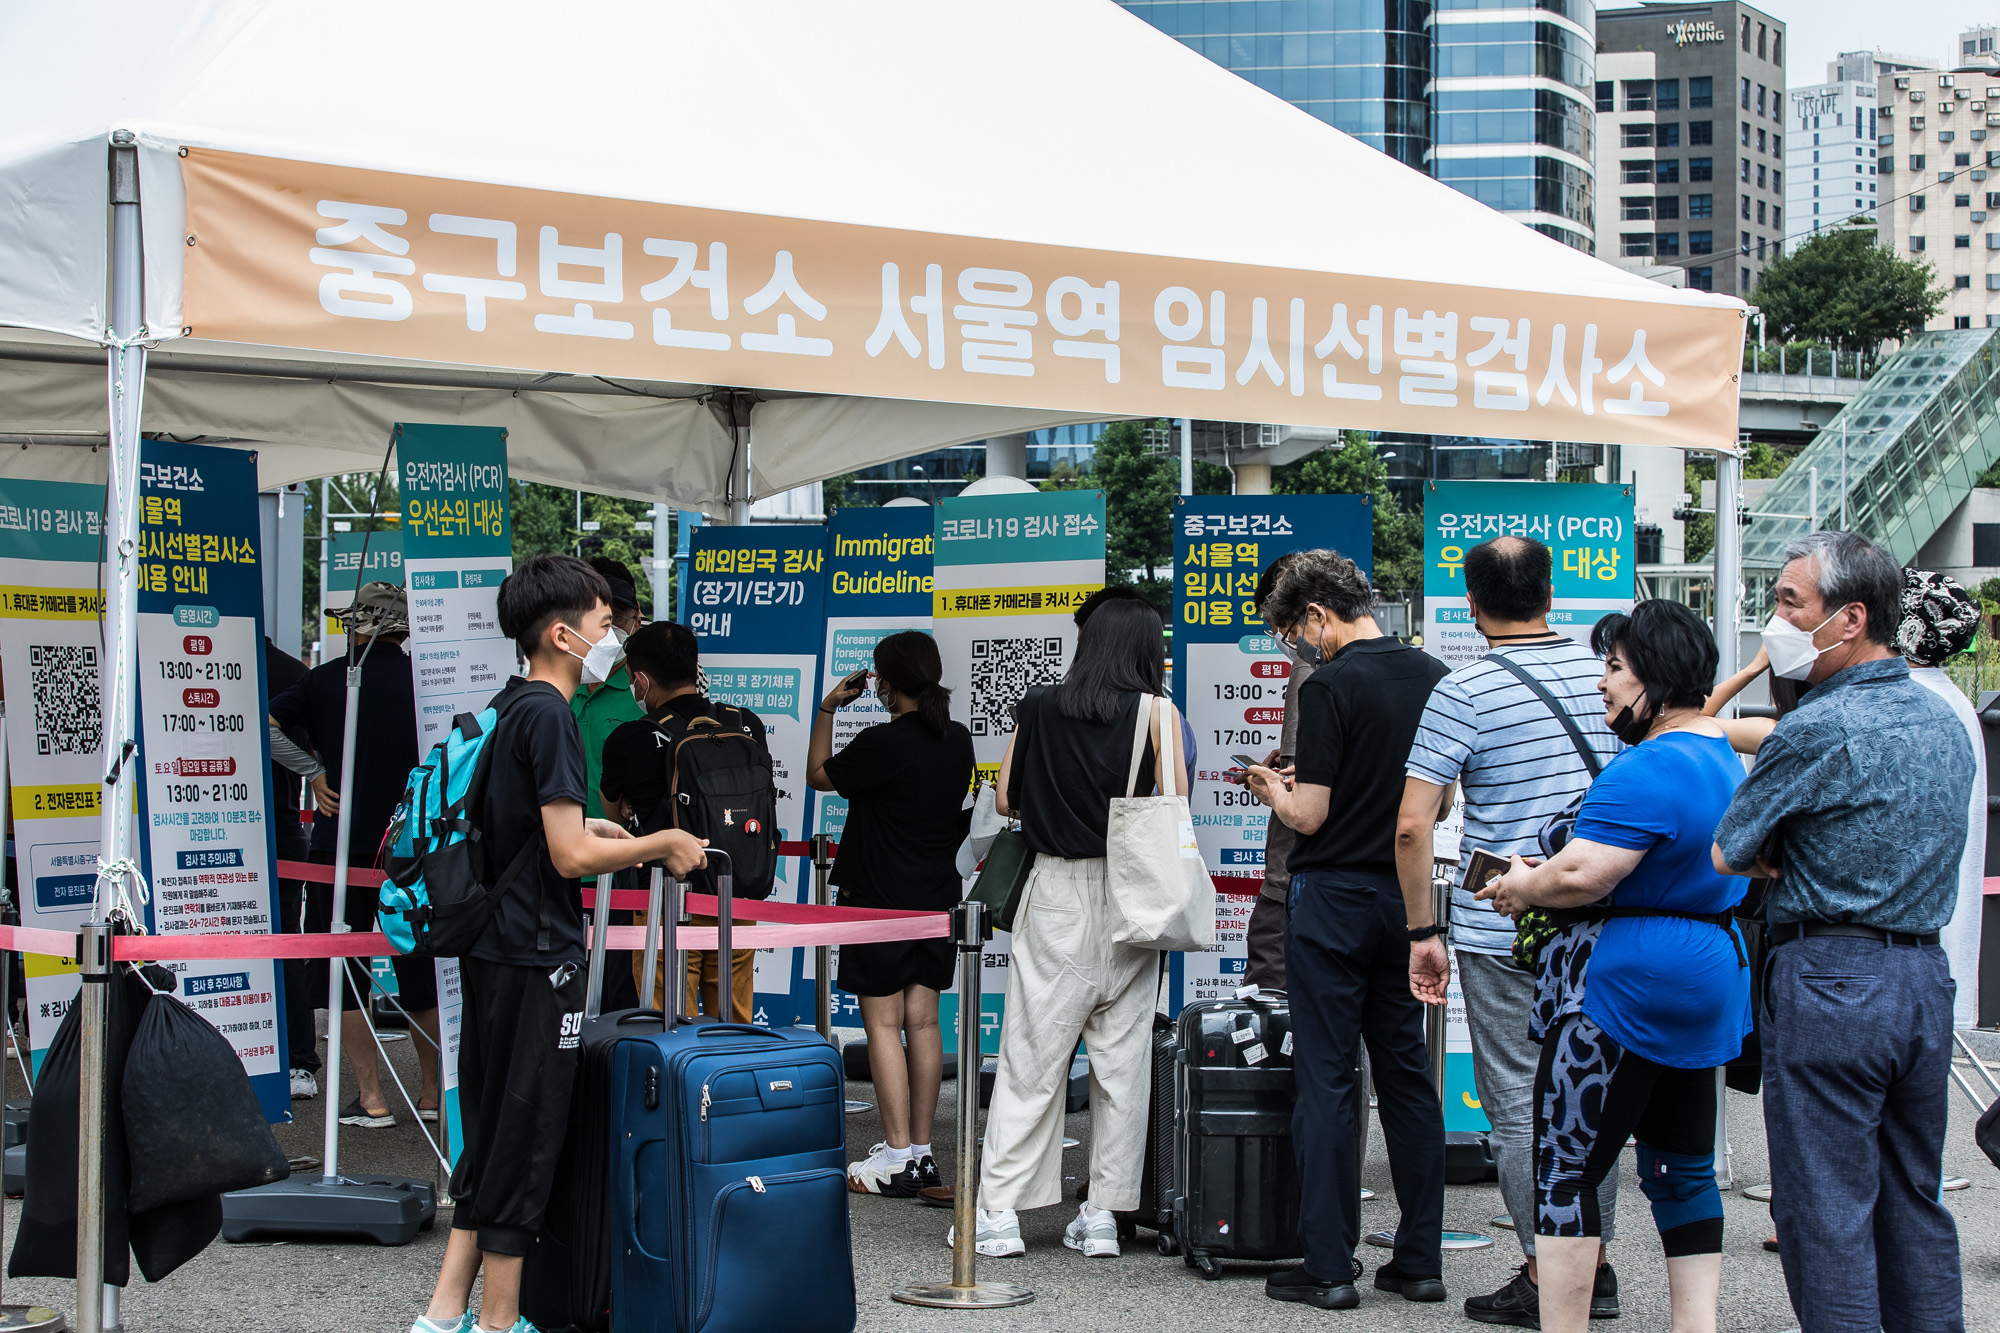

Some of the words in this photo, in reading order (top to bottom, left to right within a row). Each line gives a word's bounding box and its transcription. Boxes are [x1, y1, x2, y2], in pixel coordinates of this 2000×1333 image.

[1666, 20, 1715, 35] KWANG
[309, 199, 834, 358] 중구보건소
[865, 261, 1122, 385] 서울역
[1154, 285, 1670, 417] 임시선별검사소
[140, 462, 205, 492] 구보건소
[405, 461, 467, 492] 유전자검사
[469, 463, 503, 493] (PCR)
[55, 509, 83, 535] 검사
[408, 499, 471, 537] 우선순위
[474, 499, 504, 537] 대상
[941, 517, 1019, 541] 코로나19
[1023, 514, 1060, 539] 검사
[1063, 513, 1099, 537] 접수
[1183, 515, 1294, 537] 중구보건소
[1437, 513, 1552, 541] 유전자검사
[1557, 515, 1622, 542] (PCR)
[695, 549, 778, 573] 해외입국
[783, 548, 825, 573] 검사
[1183, 543, 1259, 568] 서울역
[1563, 546, 1621, 581] 대상
[137, 563, 168, 593] 이용
[171, 565, 208, 594] 안내
[1183, 572, 1265, 597] 임시선
[693, 580, 805, 606] (장기/단기)
[13, 593, 39, 612] 휴대폰
[39, 595, 77, 614] 카메라를
[941, 597, 953, 612] 1.
[955, 595, 992, 612] 휴대폰
[994, 592, 1043, 610] 카메라를
[1045, 591, 1070, 609] 켜서
[180, 609, 213, 624] 운영시간
[1183, 601, 1234, 626] 이용
[691, 612, 732, 637] 안내
[190, 639, 206, 652] 평일
[836, 634, 876, 645] Koreans
[159, 661, 193, 680] 13:00
[205, 663, 242, 681] 21:00
[834, 660, 859, 672] (over
[1261, 664, 1283, 676] 평일
[737, 674, 747, 688] 및
[751, 674, 794, 689] 장기체류
[187, 692, 214, 705] 소독시간
[1214, 684, 1262, 700] 13:00
[767, 694, 793, 708] 이상)
[853, 704, 873, 713] local
[874, 704, 889, 713] hea
[163, 714, 196, 732] 17:00
[209, 714, 244, 733] 18:00
[836, 720, 871, 729] (long-term
[1214, 730, 1262, 745] 17:00
[154, 761, 180, 775] 토요일
[181, 760, 200, 773] 일요일
[201, 760, 208, 773] 및
[209, 760, 230, 773] 공휴일
[167, 784, 199, 802] 13:00
[212, 783, 248, 801] 21:00
[35, 794, 46, 810] 2.
[47, 791, 95, 810] 전자문진표
[826, 805, 849, 816] Shor
[153, 812, 190, 827] 검사시간을
[191, 811, 219, 825] 고려하여
[221, 810, 247, 824] 10분전
[248, 810, 262, 823] 접수
[1192, 815, 1243, 827] 검사시간을
[190, 828, 228, 842] 마감합니다.
[50, 853, 100, 867] 서울특별시중구보
[185, 853, 199, 867] 검사
[200, 853, 206, 866] 전
[207, 852, 237, 866] 주의사항
[1233, 851, 1253, 863] 검사
[216, 873, 234, 884] 연관성
[235, 872, 248, 883] 있는
[54, 886, 67, 898] 전자
[67, 885, 86, 898] 문진표
[164, 920, 189, 931] 검사결과는
[232, 916, 243, 926] 문자
[1220, 933, 1243, 942] 필요한
[192, 979, 206, 993] 검사
[207, 979, 214, 991] 후
[215, 976, 243, 990] 주의사항
[1195, 978, 1211, 987] 검사
[1212, 978, 1219, 987] 후
[1221, 978, 1237, 988] 버스,
[242, 994, 260, 1005] 이용이
[1195, 990, 1219, 999] 합니다.
[249, 1020, 261, 1031] 하며,
